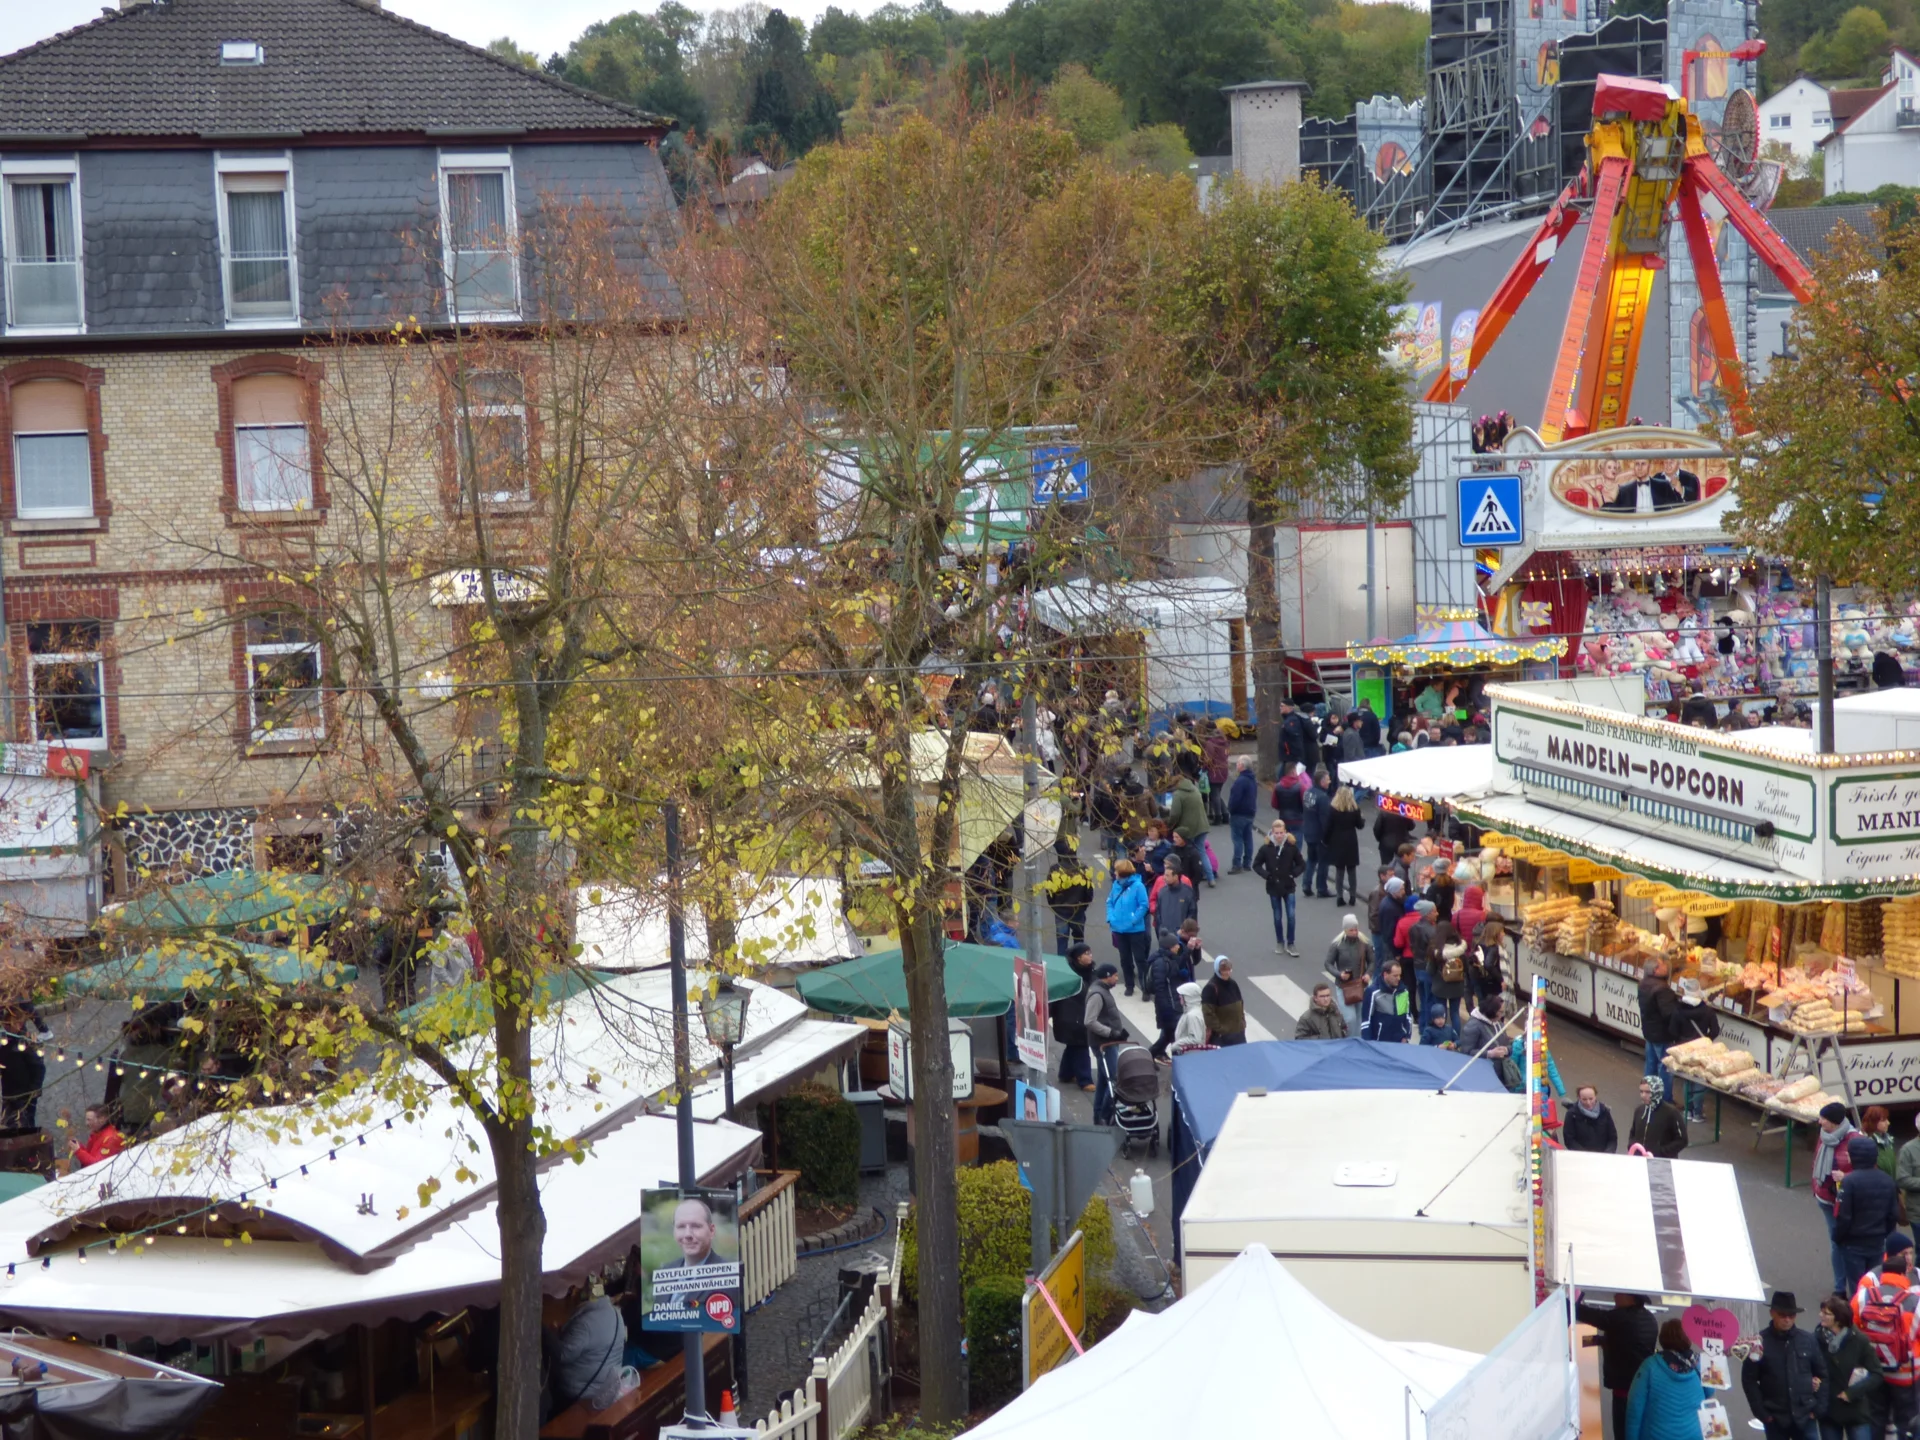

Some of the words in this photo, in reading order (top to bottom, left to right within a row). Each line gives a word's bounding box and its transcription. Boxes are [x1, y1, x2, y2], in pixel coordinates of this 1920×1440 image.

[1585, 720, 1605, 735] RIES
[1764, 780, 1790, 801] Eigene
[1849, 785, 1897, 804] Frisch
[1754, 799, 1801, 827] Herstellung
[1846, 849, 1893, 870] Eigene
[1730, 883, 1781, 898] Mandeln
[1798, 885, 1842, 899] Popcorn
[1605, 1002, 1641, 1029] MAND
[1845, 1051, 1893, 1070] Frisch
[1899, 1056, 1920, 1073] ge
[654, 1269, 693, 1280] ASYLFLUT
[696, 1265, 732, 1275] STOPPEN
[654, 1282, 700, 1294] LACHMANN
[701, 1278, 737, 1289] WÄHLEN!
[653, 1303, 685, 1312] DANIEL
[709, 1300, 730, 1315] NPD
[649, 1310, 700, 1322] LACHMANN
